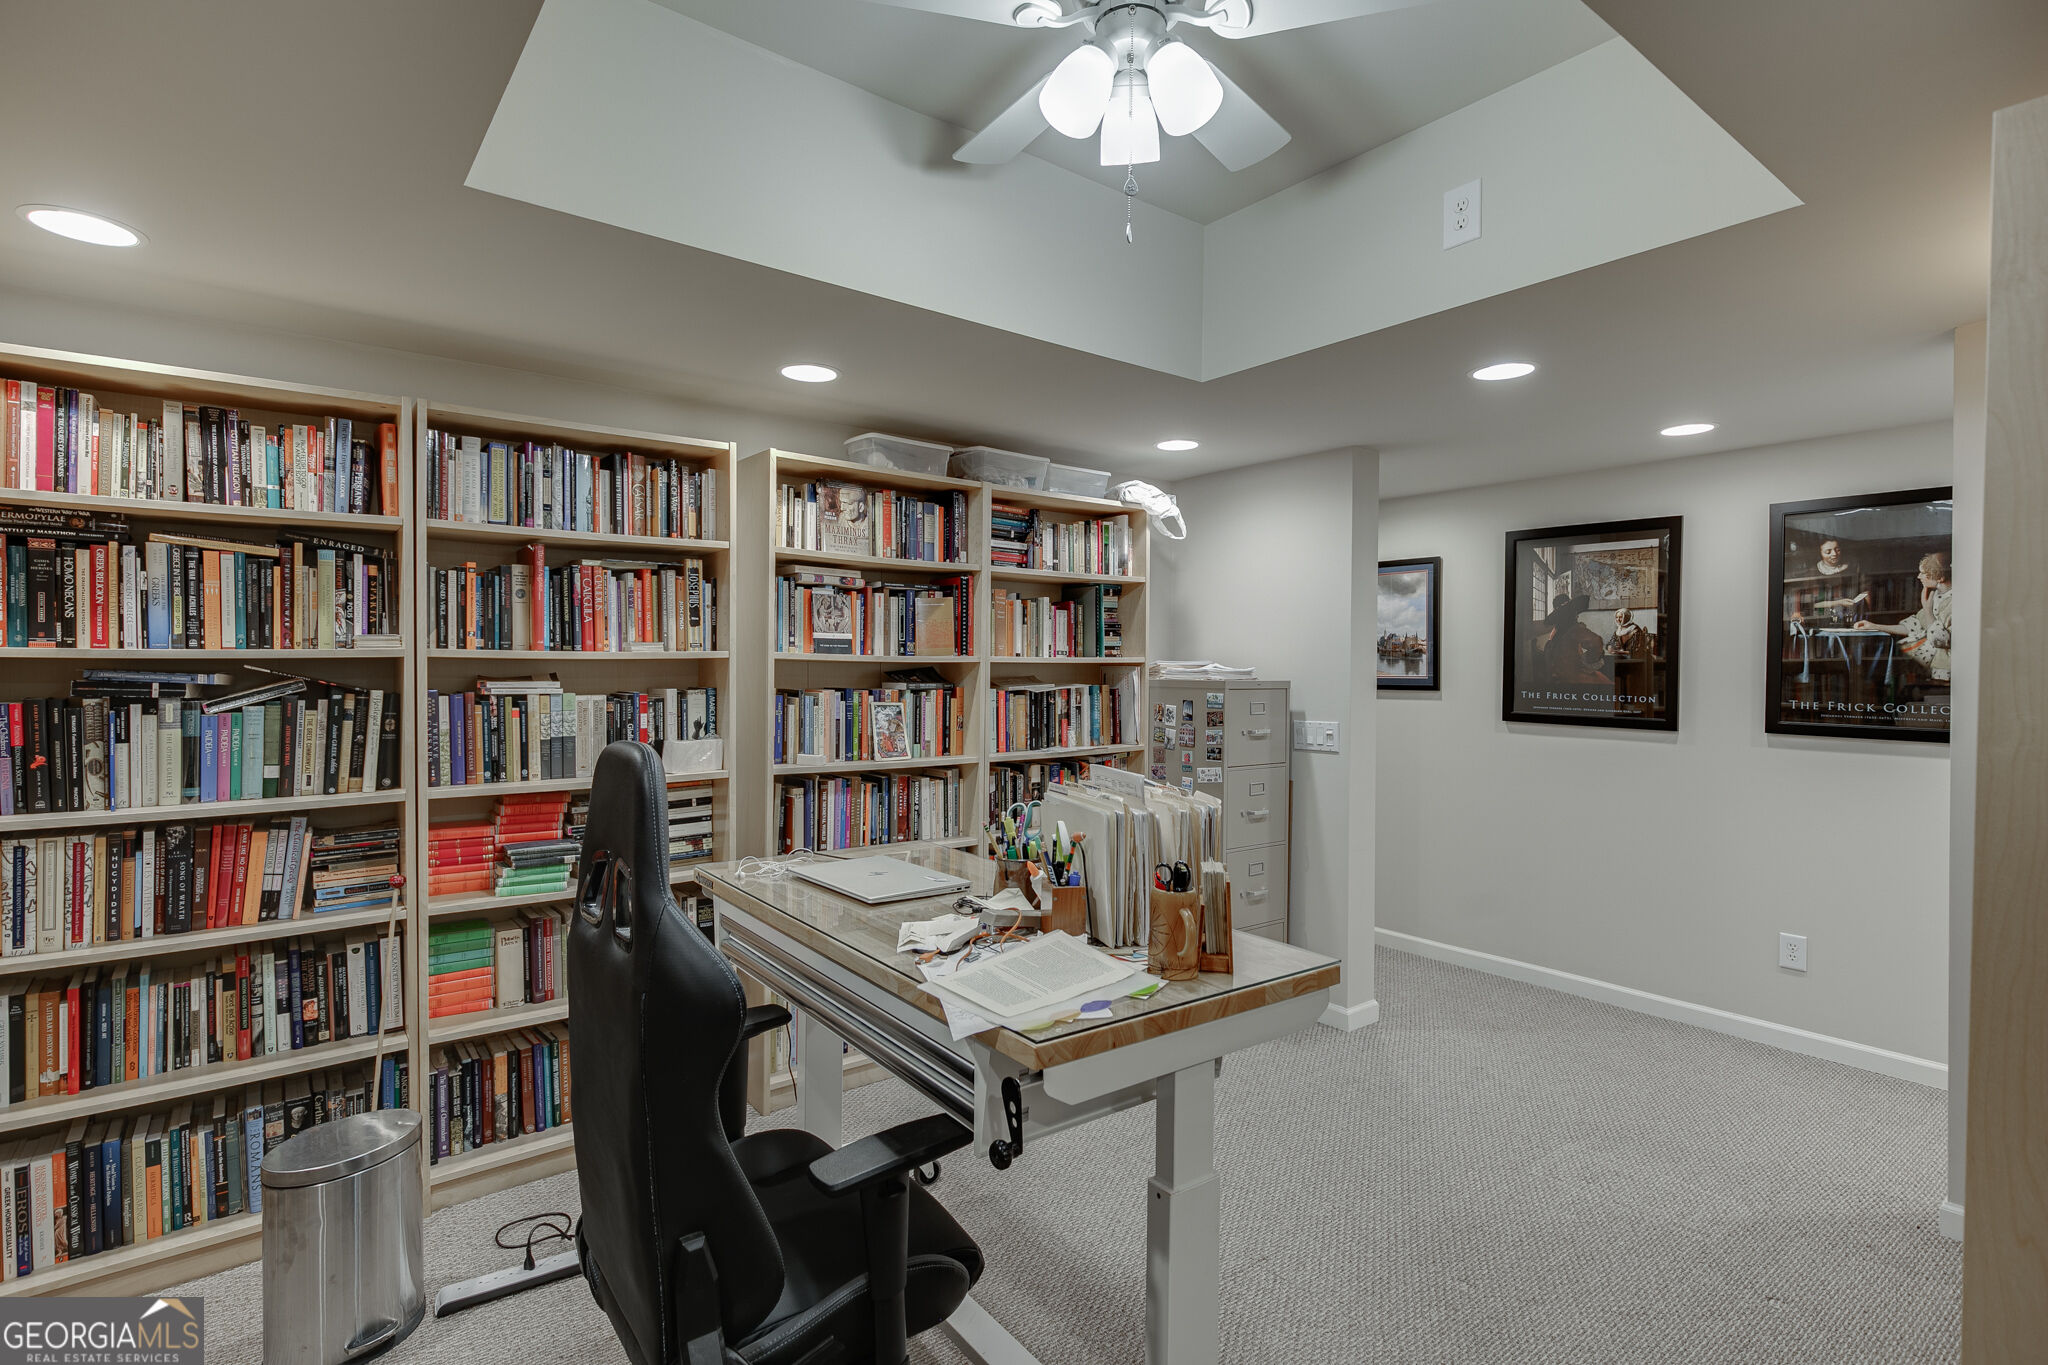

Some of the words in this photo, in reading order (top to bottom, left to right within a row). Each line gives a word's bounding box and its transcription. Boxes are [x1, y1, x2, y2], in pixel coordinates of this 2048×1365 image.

[230, 429, 239, 462] EGYPTIAN
[232, 464, 240, 493] RELIGION
[354, 472, 363, 505] PERSIANS
[670, 468, 678, 488] NOISE
[633, 483, 644, 520] CAESAR
[670, 496, 678, 513] WAR
[825, 524, 866, 538] MAXIMINUS
[833, 534, 859, 545] THRAX
[313, 538, 365, 552] ENRAGED
[64, 557, 73, 584] HOMO
[96, 548, 104, 571] GREEK
[188, 560, 196, 568] THE
[188, 569, 196, 580] WAR
[96, 572, 104, 604] RELIGION
[152, 577, 160, 606] GREEKS
[594, 575, 603, 610] CLAUDIUS
[689, 573, 699, 608] JOSEPHUS
[65, 585, 74, 618] NECANS
[188, 595, 196, 616] ACHILLES
[583, 578, 592, 622] CALIGULA
[1521, 691, 1541, 699] THE
[1546, 692, 1578, 700] FRICK
[1582, 693, 1656, 704] COLLECTION
[1789, 700, 1819, 711] THE
[1827, 702, 1876, 712] FRICK
[1883, 703, 1950, 715] COLLEC
[1, 716, 9, 729] The
[305, 718, 313, 726] THE
[1, 730, 9, 748] Children
[205, 730, 213, 753] PAIDEIA
[220, 729, 228, 752] PAIDEIA
[232, 728, 240, 751] PAIDEIA
[305, 728, 313, 741] GREEK
[1, 749, 9, 757] of
[305, 742, 313, 774] COMMONWEALT
[295, 820, 303, 832] The
[291, 833, 301, 862] Classical
[144, 844, 153, 878] PERICLES
[240, 856, 246, 865] NO
[287, 863, 297, 884] Greeks
[179, 883, 185, 891] OF
[144, 886, 153, 918] ATHENS
[393, 984, 400, 992] TO
[240, 996, 248, 1007] GODS
[47, 1058, 53, 1066] OF
[315, 1095, 324, 1124] Cartha
[70, 1161, 79, 1185] WOMEN
[136, 1156, 144, 1188] CLASSICAL
[250, 1134, 261, 1190] ROMANS
[17, 1190, 28, 1232] EROS
[70, 1196, 80, 1226] CLASSICAL
[123, 1198, 131, 1226] Momigliano
[71, 1225, 80, 1248] WORLD
